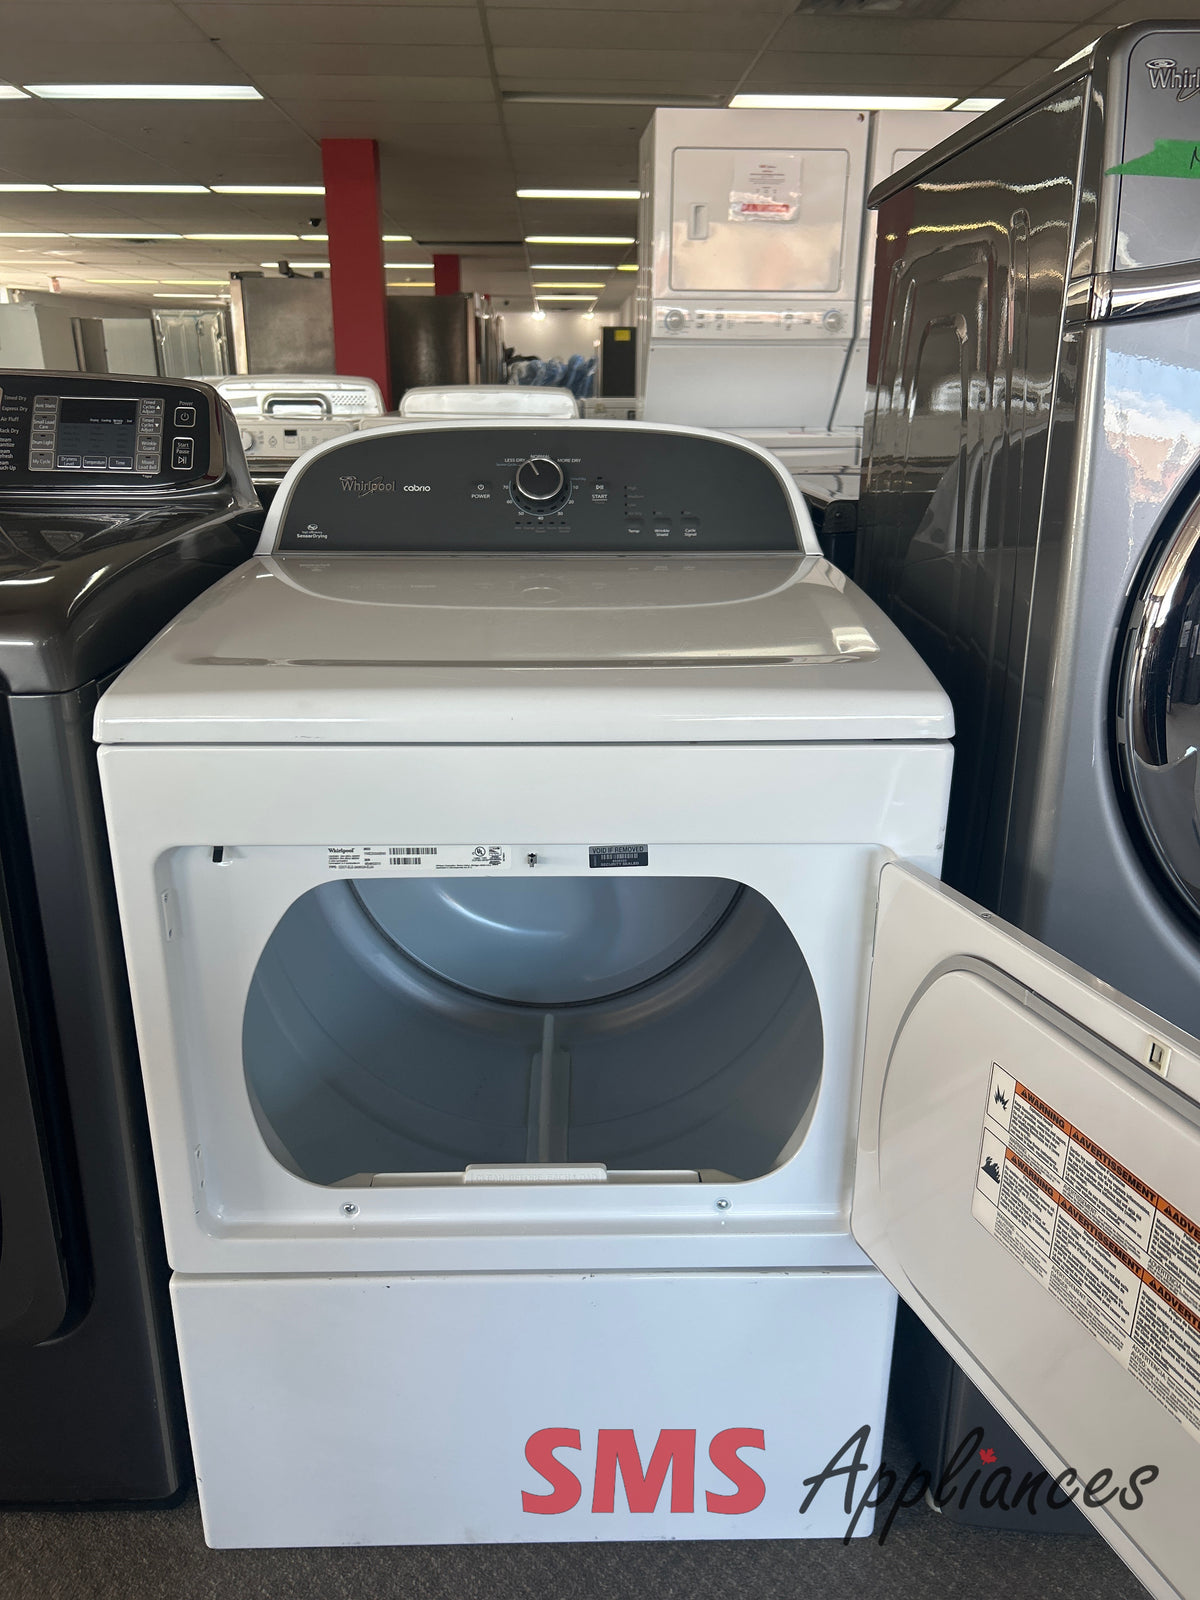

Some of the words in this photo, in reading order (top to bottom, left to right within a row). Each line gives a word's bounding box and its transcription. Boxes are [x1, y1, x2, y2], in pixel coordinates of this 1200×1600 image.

[340, 476, 396, 496] Whirlpool
[403, 484, 431, 492] cabrio
[1026, 1091, 1065, 1129] WARNING
[1016, 1157, 1054, 1197] WARNING
[1078, 1135, 1156, 1203] AVERTISSEMENT
[1066, 1202, 1141, 1276] AVERTISSEMENT
